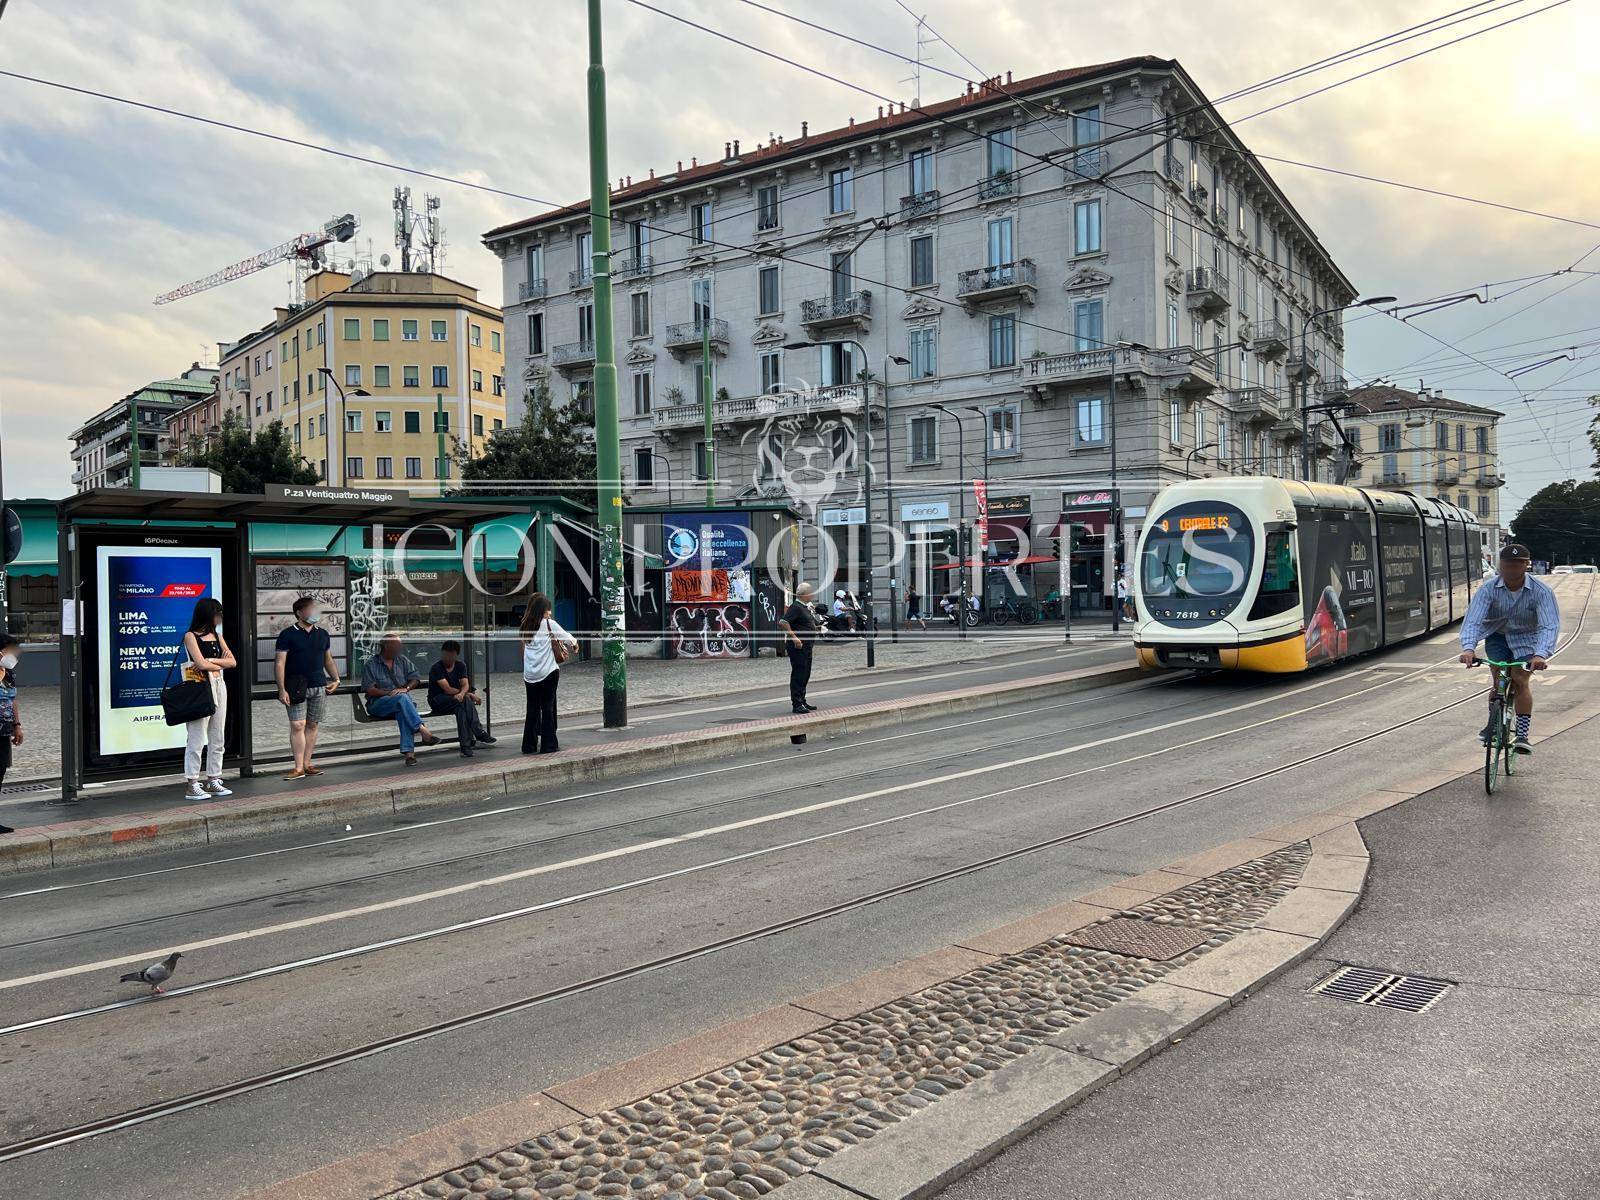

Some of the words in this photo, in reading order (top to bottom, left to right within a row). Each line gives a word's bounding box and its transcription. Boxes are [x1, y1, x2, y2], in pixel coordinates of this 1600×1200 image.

[284, 488, 304, 497] P.za
[305, 489, 360, 501] Ventiquattro
[361, 491, 393, 502] Maggio
[1162, 520, 1169, 532] 9
[702, 529, 725, 538] Qualità
[712, 539, 746, 548] eccellenza
[119, 611, 148, 620] LIMA
[1176, 611, 1199, 619] 7619
[120, 647, 146, 656] NEW
[149, 645, 180, 655] YORK
